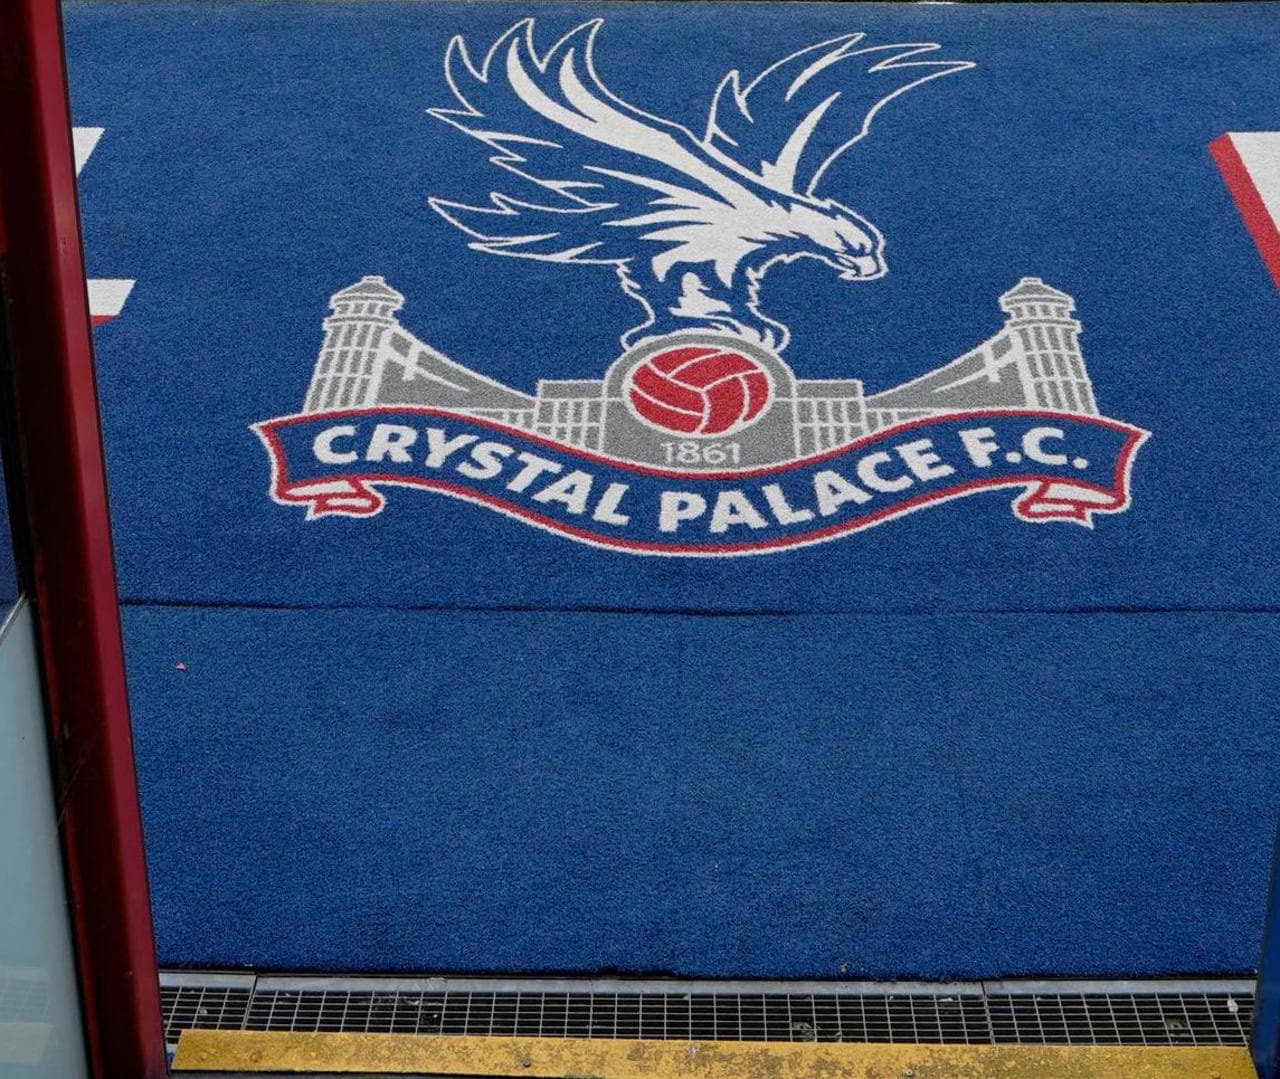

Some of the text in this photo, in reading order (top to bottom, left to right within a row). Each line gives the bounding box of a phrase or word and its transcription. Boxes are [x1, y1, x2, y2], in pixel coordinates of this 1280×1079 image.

[312, 423, 1089, 533] CRYSTAL PALACE F.C.
[660, 440, 740, 465] 1861
